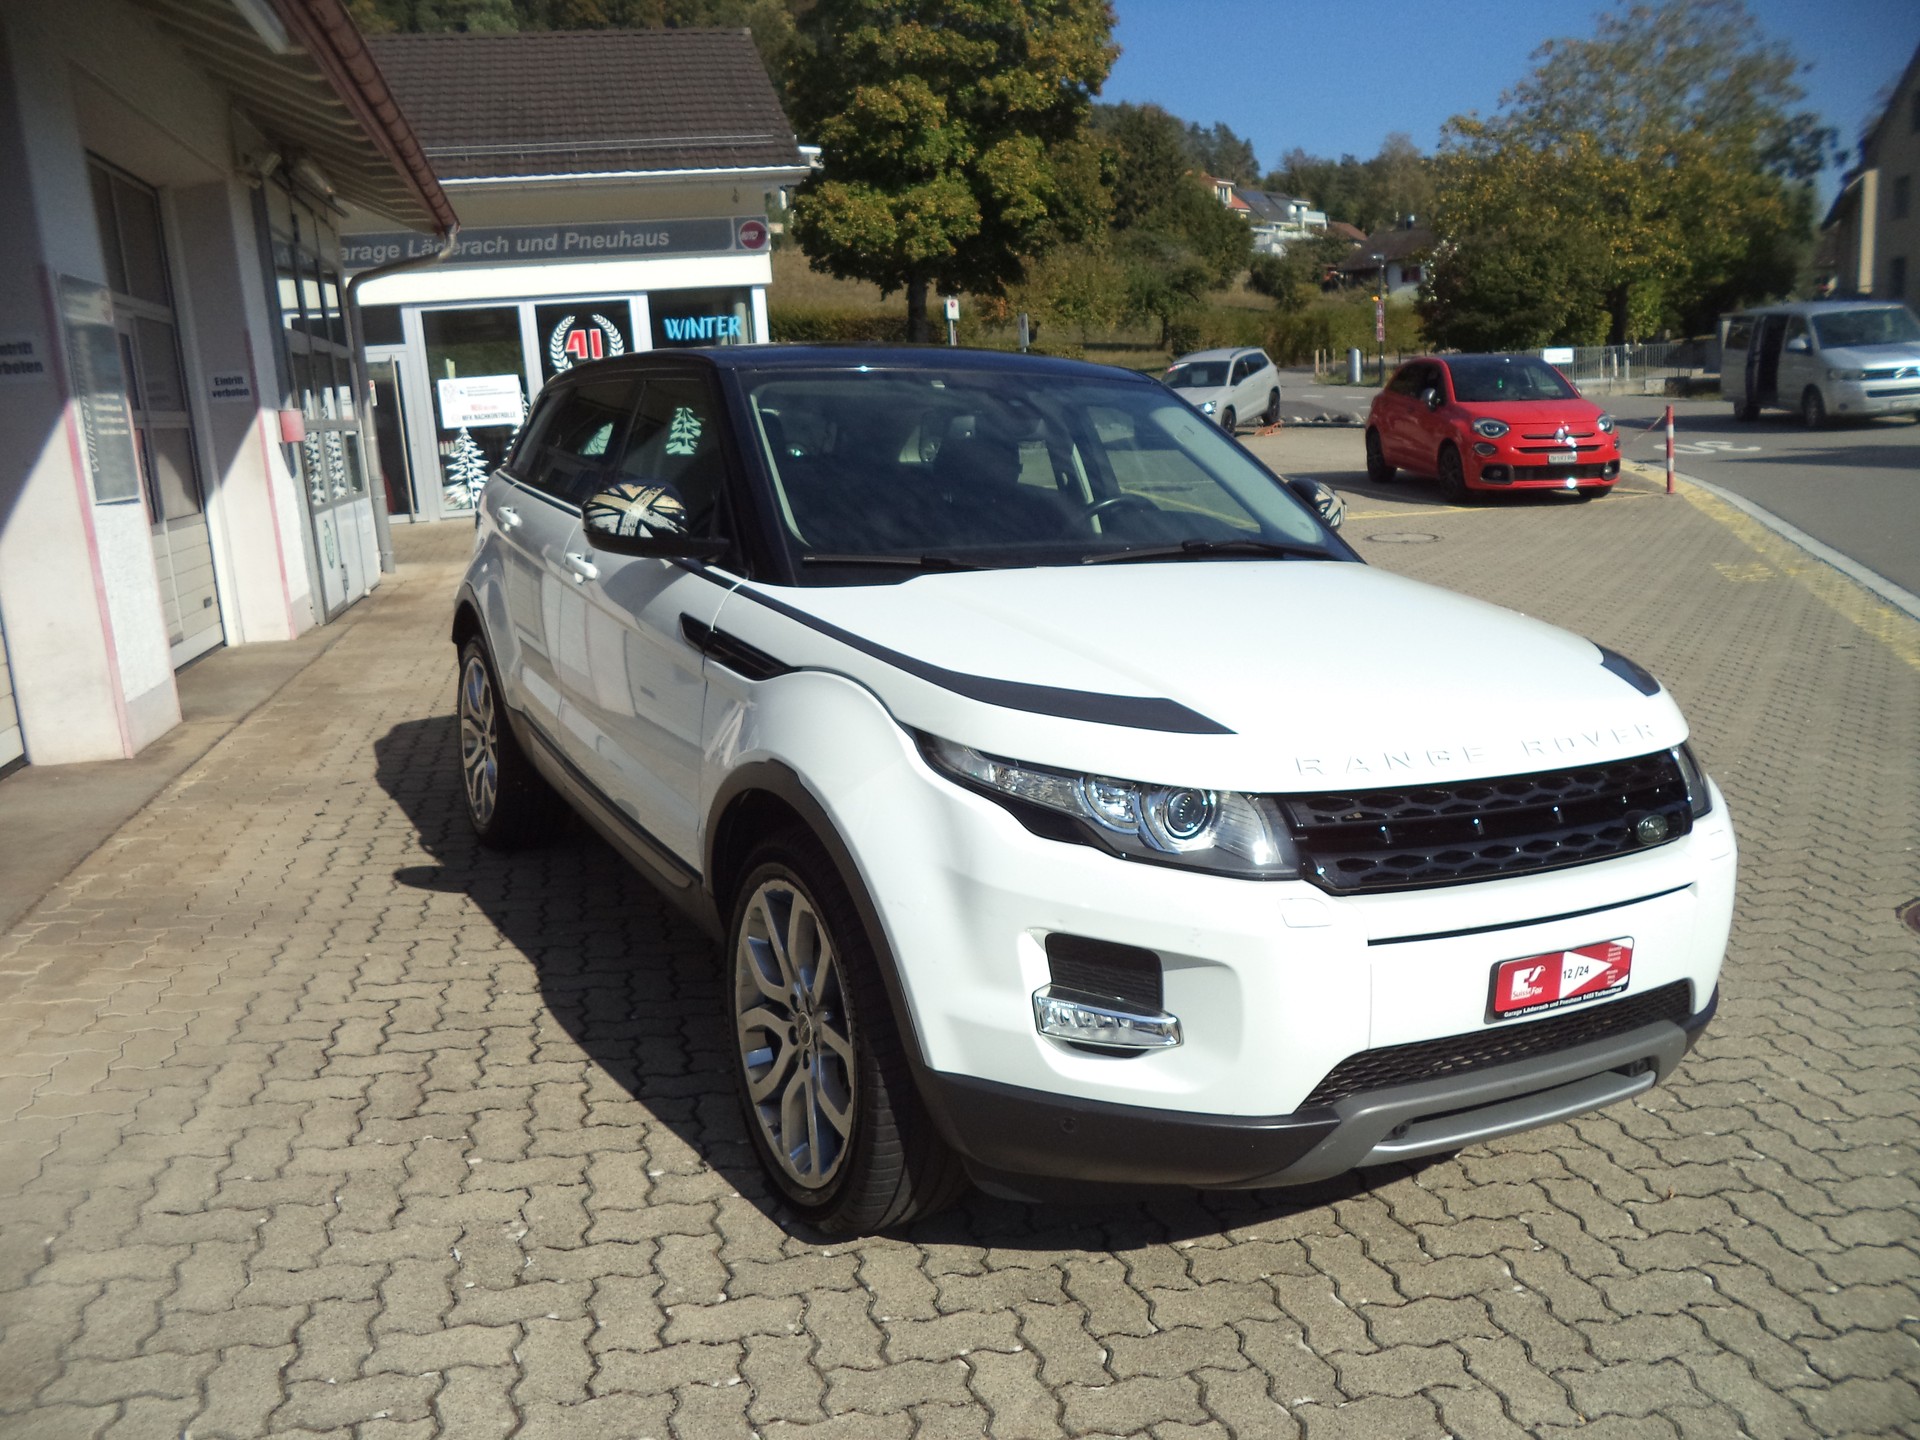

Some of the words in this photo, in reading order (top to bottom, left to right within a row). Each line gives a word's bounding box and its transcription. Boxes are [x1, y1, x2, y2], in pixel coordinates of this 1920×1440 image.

[340, 243, 400, 264] arage
[516, 231, 558, 252] und
[565, 229, 671, 250] Pneuhaus
[664, 315, 742, 340] WINTER
[0, 341, 33, 355] ntritt
[0, 361, 43, 374] rboten
[214, 376, 244, 386] Eintritt
[212, 388, 250, 398] verboten
[1295, 745, 1486, 775] RANGE
[1521, 723, 1655, 756] ROVER
[1563, 968, 1573, 980] 12
[1574, 965, 1589, 980] /24
[1504, 1009, 1523, 1018] Garage
